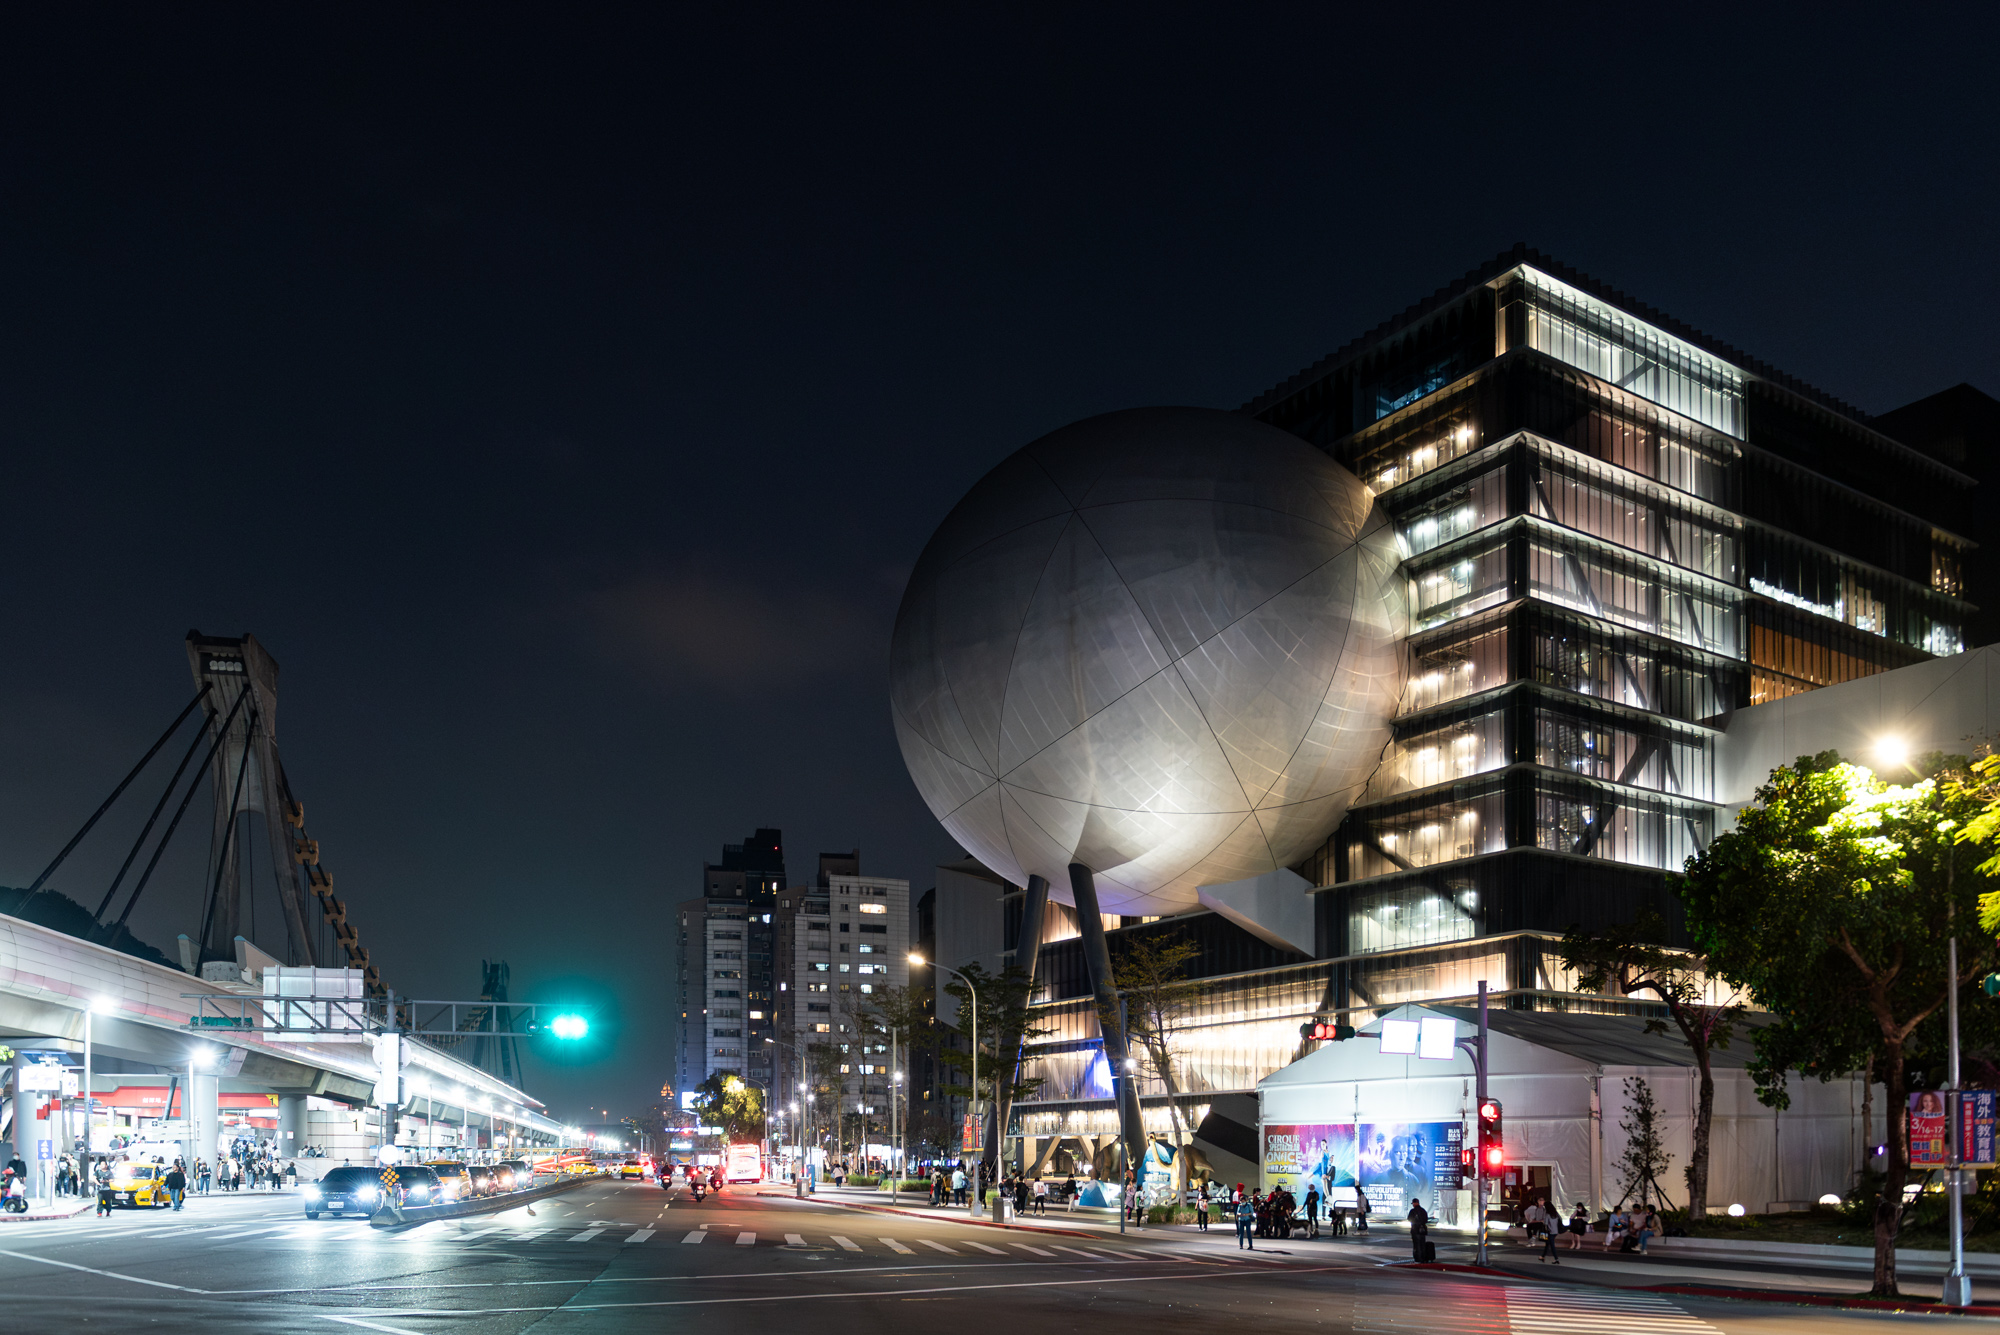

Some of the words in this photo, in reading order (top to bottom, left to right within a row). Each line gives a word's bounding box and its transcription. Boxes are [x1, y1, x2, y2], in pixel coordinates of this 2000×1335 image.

[269, 1097, 274, 1106] 1
[352, 1118, 358, 1132] 1
[1268, 1135, 1300, 1145] CIRQUE
[1977, 1125, 1991, 1162] 教育展
[1267, 1152, 1281, 1162] ON
[1284, 1152, 1303, 1163] ICE
